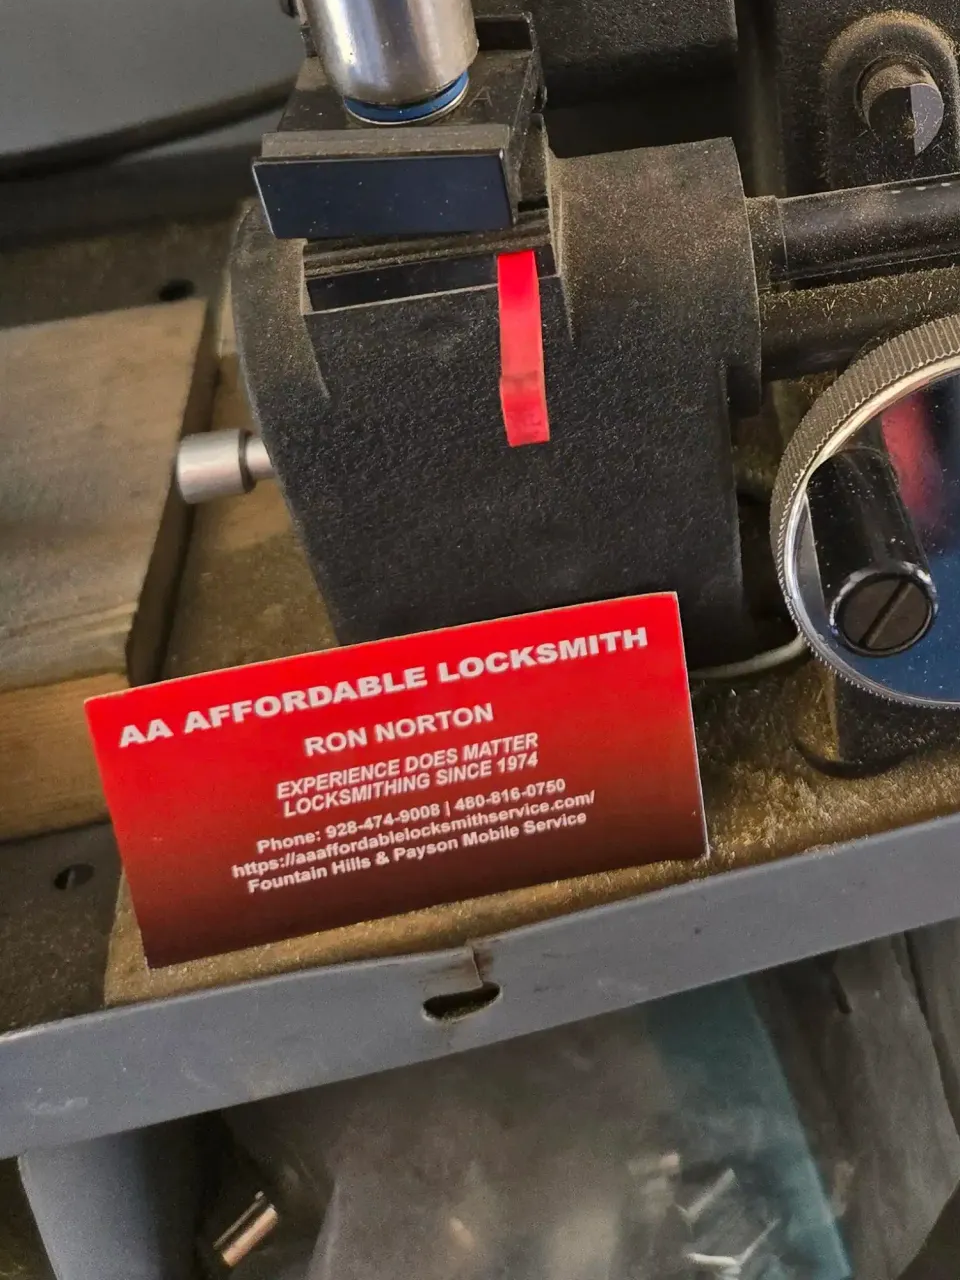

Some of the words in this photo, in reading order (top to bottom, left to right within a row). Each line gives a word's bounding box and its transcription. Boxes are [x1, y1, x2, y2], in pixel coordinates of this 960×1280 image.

[119, 718, 174, 748] AA
[183, 666, 428, 734] AFFORDABLE
[438, 627, 648, 683] LOCKSMITH
[276, 758, 401, 800] EXPERIENCE
[405, 747, 458, 773] DOES
[463, 732, 539, 762] MATTER
[304, 730, 368, 757] RON
[376, 703, 494, 743] NORTON
[255, 829, 322, 854] Phone:
[324, 805, 441, 839] 928-474-9008
[453, 778, 567, 812] 480-816-0750
[282, 772, 431, 819] LOCKSMITHING
[435, 759, 493, 787] SINCE
[496, 751, 539, 774] 1974
[231, 789, 596, 879] https://aaaffordablelocksmithservice.com/
[247, 866, 328, 894] Fountain
[331, 855, 372, 875] Hills
[375, 851, 390, 866] &
[393, 836, 459, 861] Payson
[462, 826, 520, 848] Mobile
[522, 812, 588, 835] Service
